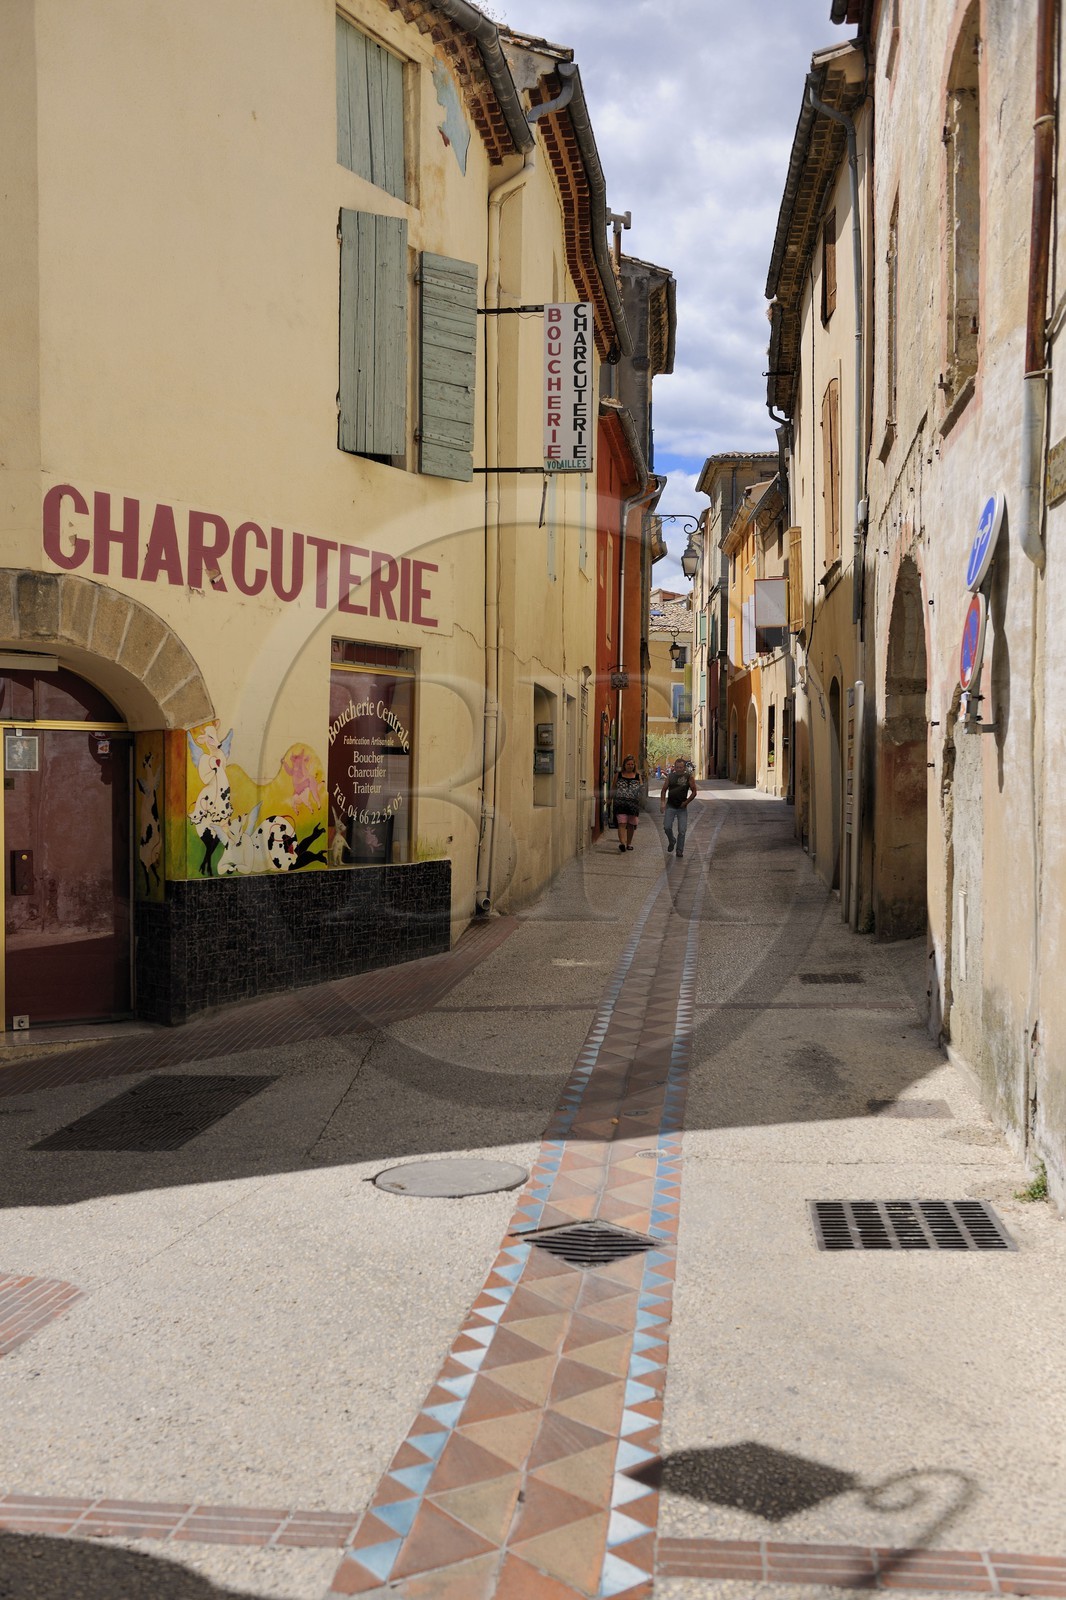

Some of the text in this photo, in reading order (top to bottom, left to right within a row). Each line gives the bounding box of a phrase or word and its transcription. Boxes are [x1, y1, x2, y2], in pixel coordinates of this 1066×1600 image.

[547, 308, 562, 459] BOUCHERIE
[573, 303, 588, 459] CHARCUTERIE
[546, 459, 588, 470] VOLAILLES
[42, 484, 439, 628] CHARCUTERIE
[328, 696, 410, 754] Boucherie Centrale
[343, 735, 394, 746] Fabrication Artisanale
[353, 750, 385, 764] Boucher
[347, 765, 387, 778] Charcutier
[352, 781, 382, 794] Traiteur
[333, 783, 403, 825] Tél. 04 66 22 35 05
